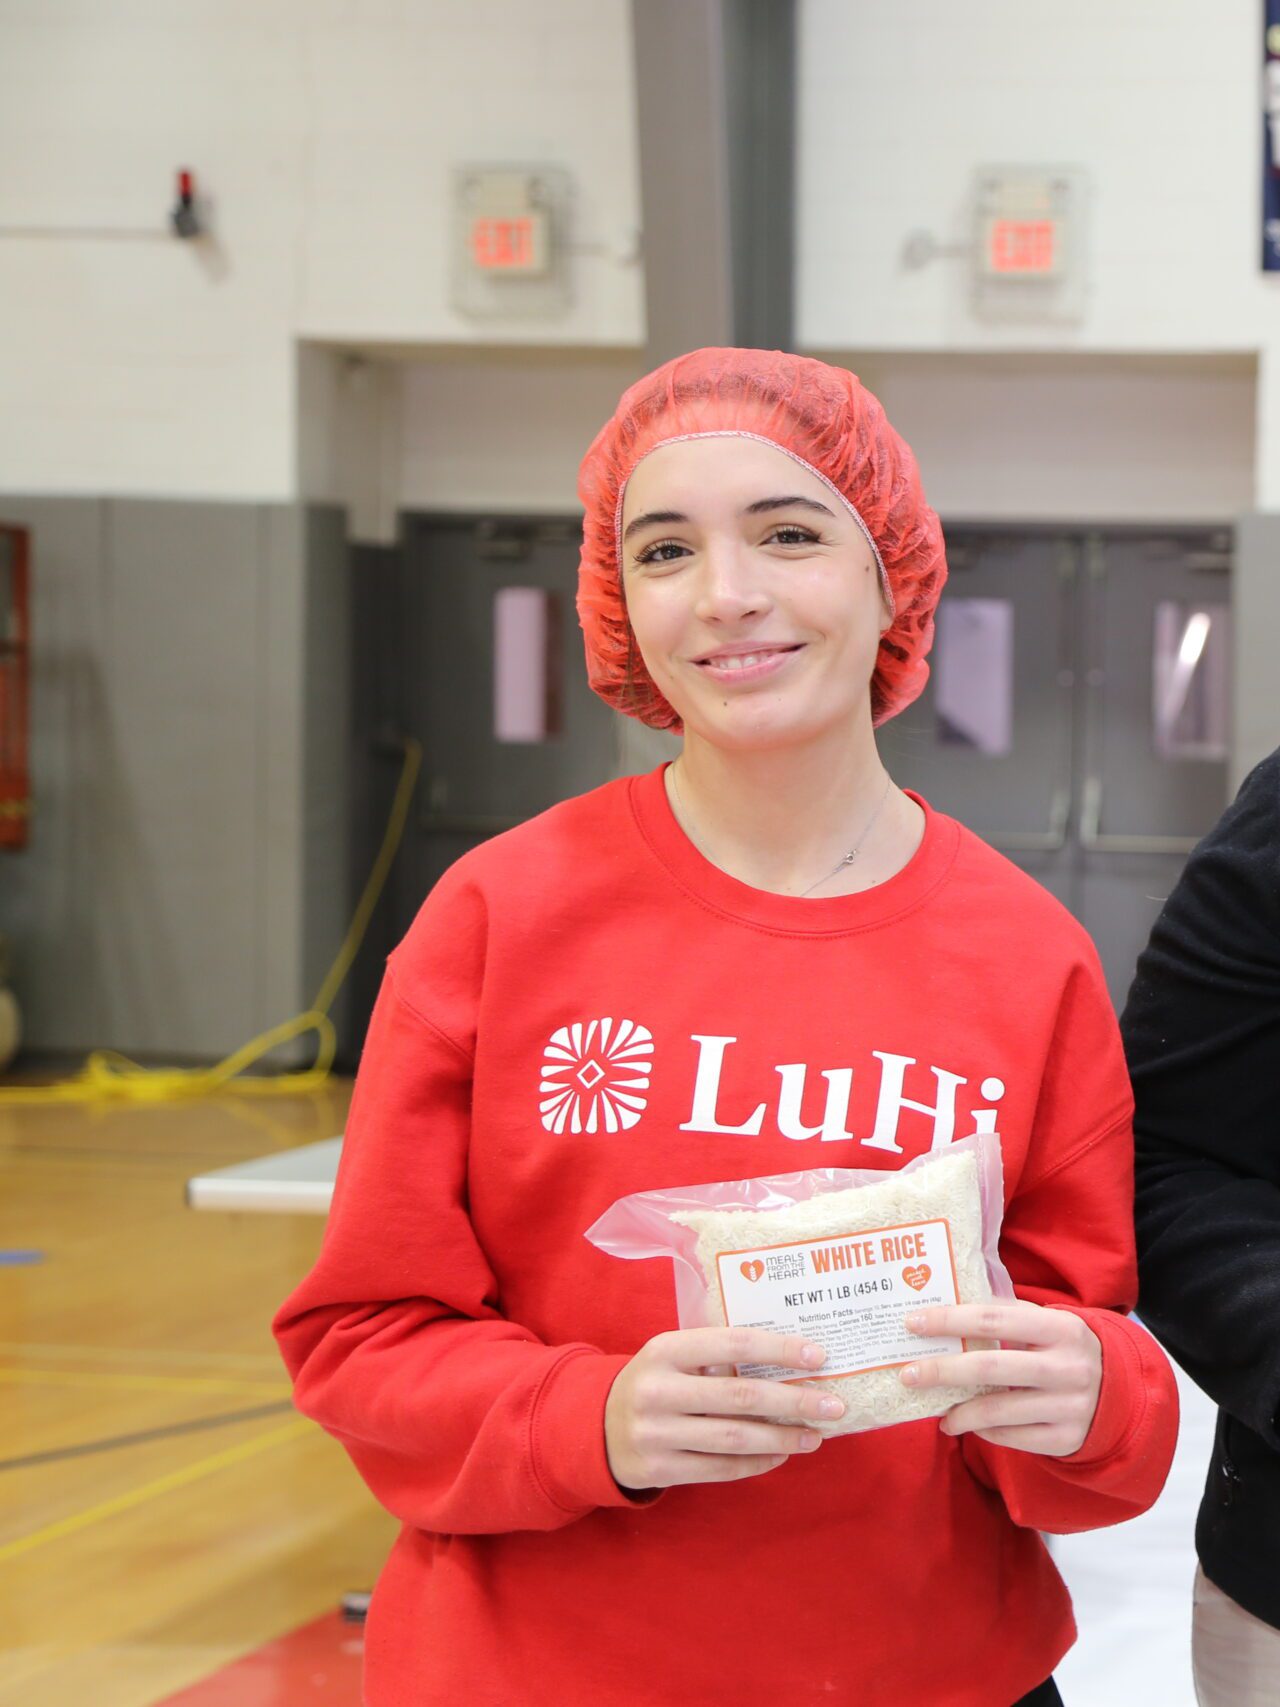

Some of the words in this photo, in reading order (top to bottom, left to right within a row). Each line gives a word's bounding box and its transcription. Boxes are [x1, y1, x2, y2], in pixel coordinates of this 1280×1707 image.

[474, 217, 533, 267] EXIT
[678, 1034, 1006, 1154] LuHi
[766, 1252, 804, 1266] MEALS
[811, 1241, 876, 1274] WHITE
[880, 1232, 927, 1263] RICE
[768, 1268, 806, 1281] HEART
[784, 1293, 804, 1307] NET
[807, 1289, 824, 1303] WT
[828, 1288, 834, 1301] 1
[837, 1286, 851, 1299] LB
[853, 1281, 878, 1297] (454
[881, 1278, 893, 1291] G)
[798, 1312, 831, 1323] Nutrition
[832, 1308, 854, 1318] Facts
[839, 1317, 860, 1326] Calories
[860, 1312, 873, 1321] 160
